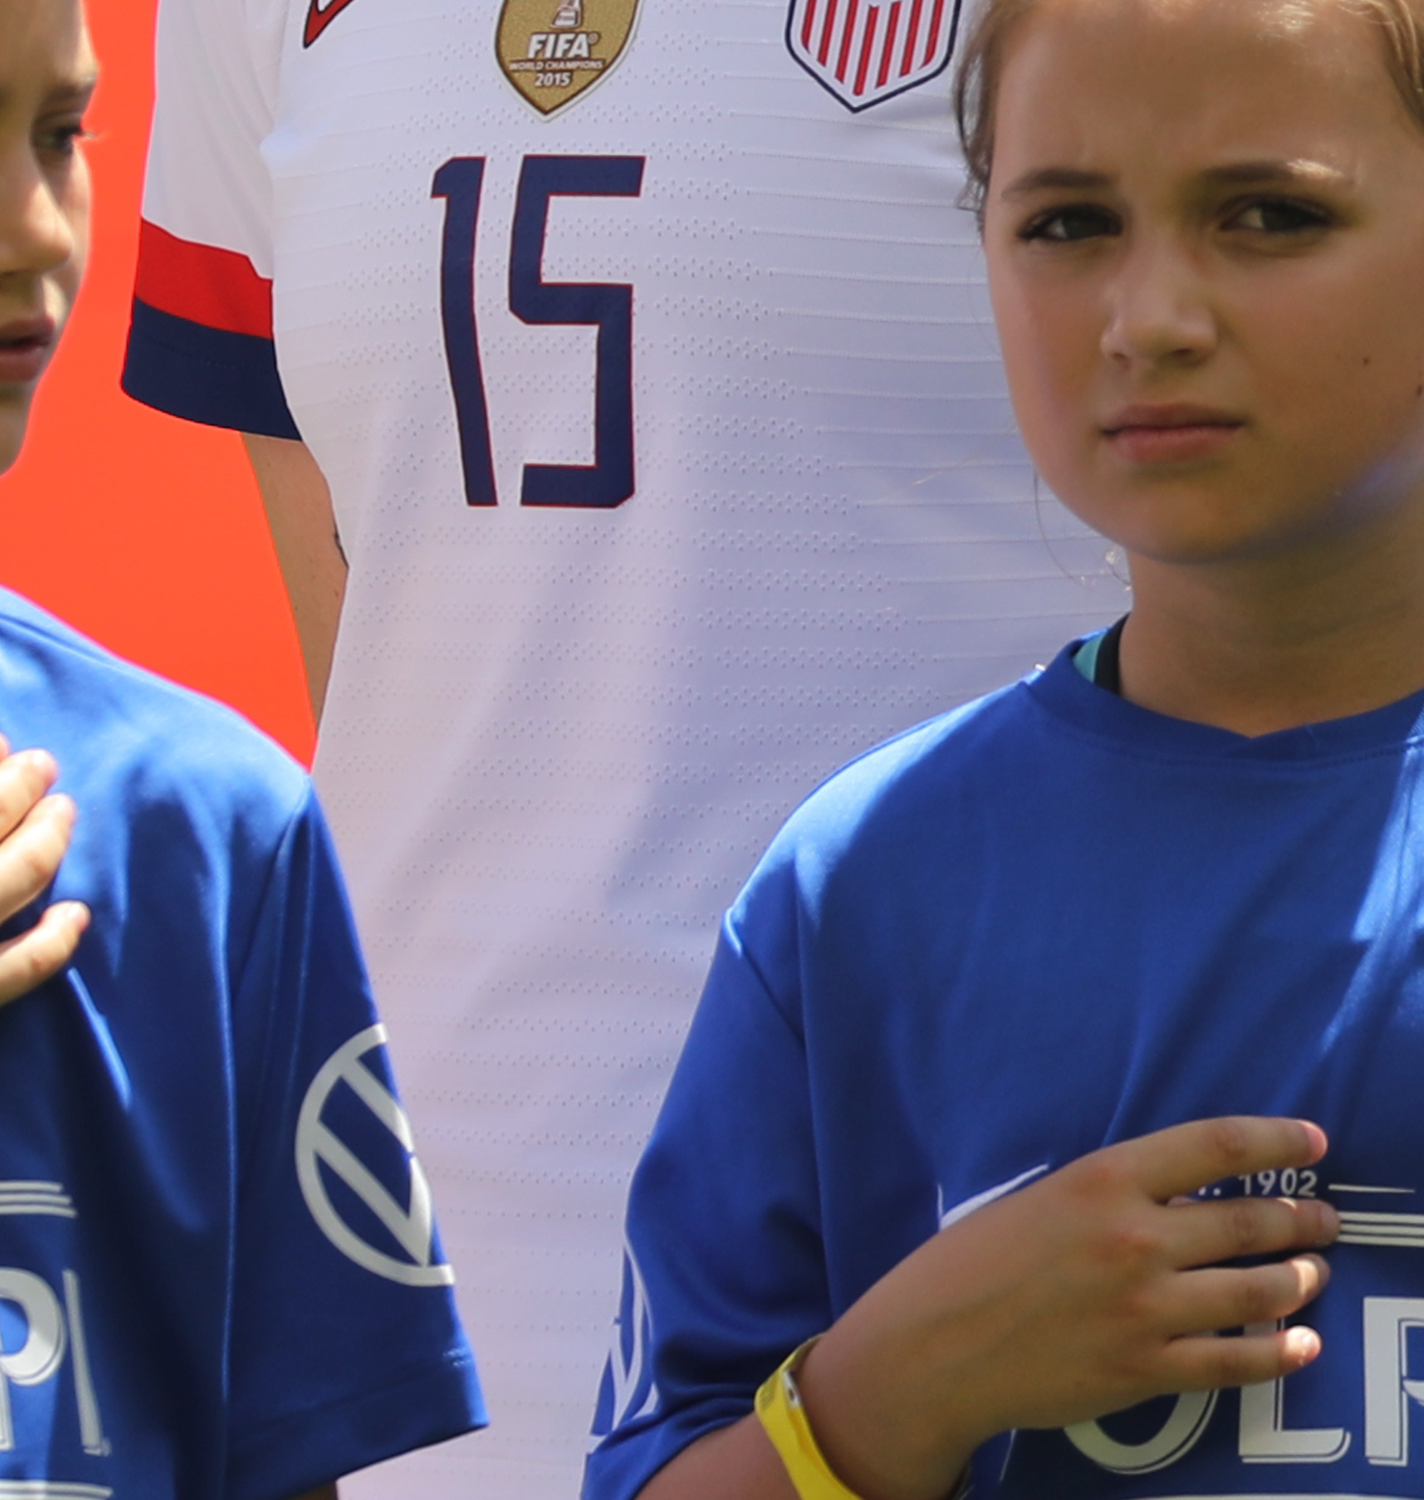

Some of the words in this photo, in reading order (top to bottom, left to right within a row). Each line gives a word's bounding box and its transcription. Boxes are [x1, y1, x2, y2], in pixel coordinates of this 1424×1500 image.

[527, 32, 590, 60] FIFA
[508, 60, 544, 72] WORLD
[545, 59, 604, 71] CHAMPIONS
[534, 72, 572, 88] 2015
[430, 155, 646, 509] 15
[1237, 1167, 1318, 1197] 1902
